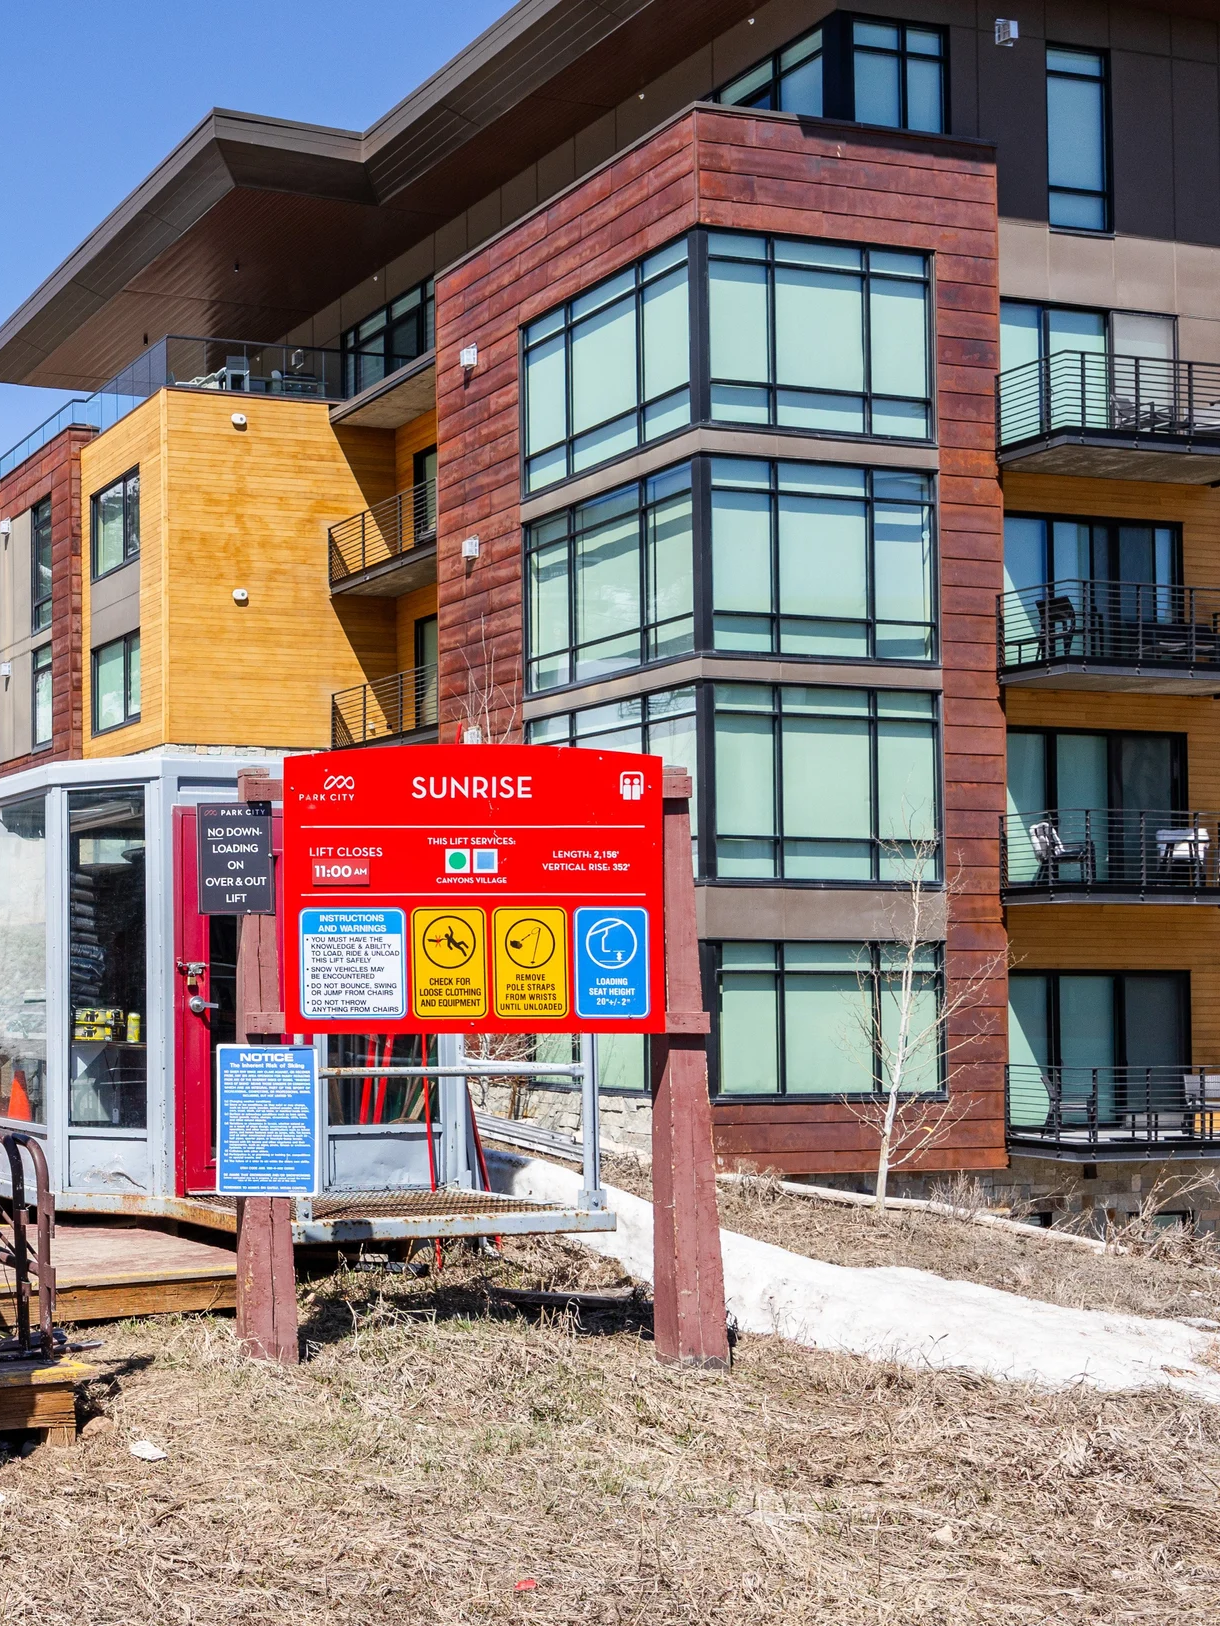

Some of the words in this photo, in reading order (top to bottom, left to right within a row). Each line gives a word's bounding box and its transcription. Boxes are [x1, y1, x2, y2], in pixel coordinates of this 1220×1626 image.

[411, 776, 533, 799] SUNRISE
[207, 828, 224, 838] NO
[226, 827, 263, 837] DOWN-
[427, 837, 448, 845] THIS
[449, 837, 469, 845] LIFT
[470, 837, 516, 845] SERVICES:
[212, 844, 259, 853] LOADING
[309, 847, 334, 857] LIFT
[336, 847, 383, 857] CLOSES
[552, 850, 592, 859] LENGTH:
[227, 861, 244, 870] ON
[542, 863, 587, 871] VERTICAL
[588, 863, 611, 871] RISE:
[314, 865, 352, 878] 11:00
[205, 877, 234, 887] OVER
[235, 877, 243, 886] &
[244, 876, 267, 886] OUT
[225, 893, 247, 903] LIFT
[319, 914, 385, 922] INSTRUCTIONS
[318, 925, 337, 933] AND
[339, 925, 387, 933] WARNINGS
[429, 978, 454, 986] CHECK
[455, 978, 471, 986] FOR
[595, 978, 628, 986] LOADING
[419, 988, 443, 996] LOOSE
[445, 988, 482, 996] CLOTHING
[588, 988, 608, 996] SEAT
[608, 988, 636, 996] HEIGHT
[505, 993, 527, 1001] FROM
[528, 993, 557, 1001] WRISTS
[420, 999, 436, 1007] AND
[438, 999, 481, 1007] EQUIPMENT
[500, 1003, 521, 1011] UNTIL
[523, 1003, 563, 1011] UNLOADED
[239, 1053, 294, 1062] NOTICE
